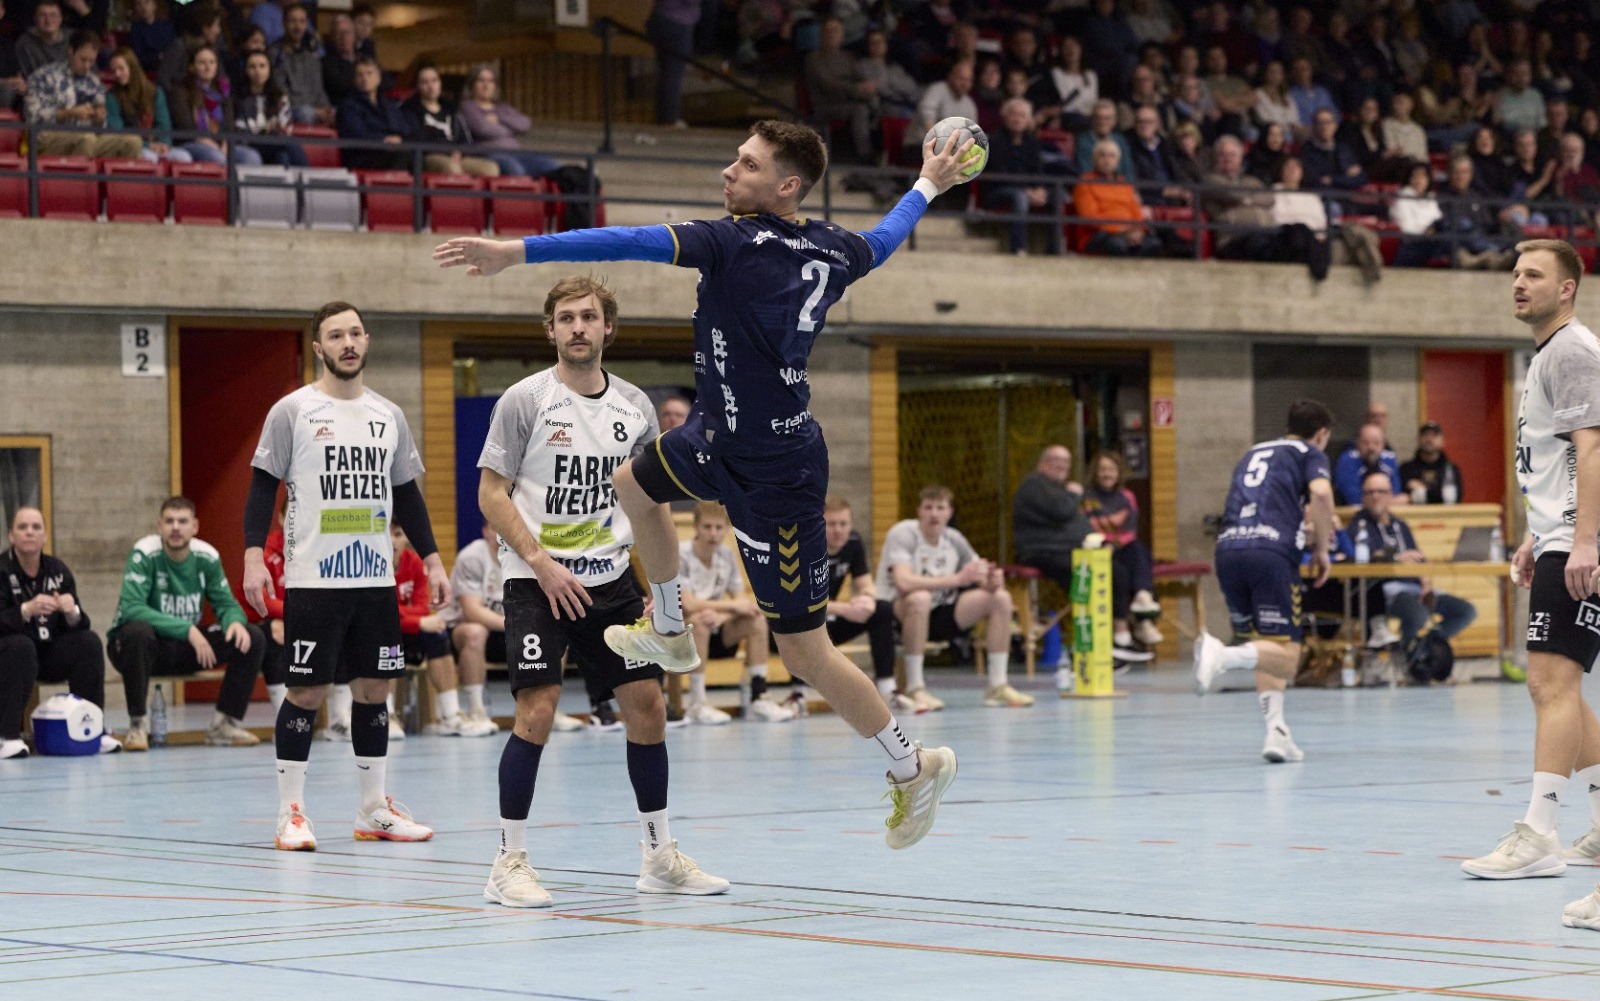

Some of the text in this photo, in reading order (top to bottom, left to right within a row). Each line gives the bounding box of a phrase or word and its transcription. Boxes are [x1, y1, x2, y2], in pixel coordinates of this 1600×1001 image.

[797, 260, 830, 331] 2
[135, 328, 149, 347] B
[136, 353, 148, 371] 2
[368, 421, 386, 438] 17
[545, 419, 573, 429] Kempa
[613, 421, 628, 442] 8
[325, 445, 387, 473] FARNY
[1244, 450, 1274, 488] 5
[320, 474, 387, 500] WEIZEN
[321, 513, 371, 523] Fischbach
[543, 527, 598, 537] Fischbach
[319, 540, 387, 578] WALDNER
[161, 592, 201, 615] FARNY
[292, 639, 317, 664] 17
[522, 633, 542, 660] 8
[289, 665, 313, 675] Kempa
[518, 661, 547, 671] Kempa
[648, 821, 657, 842] CRAFT
